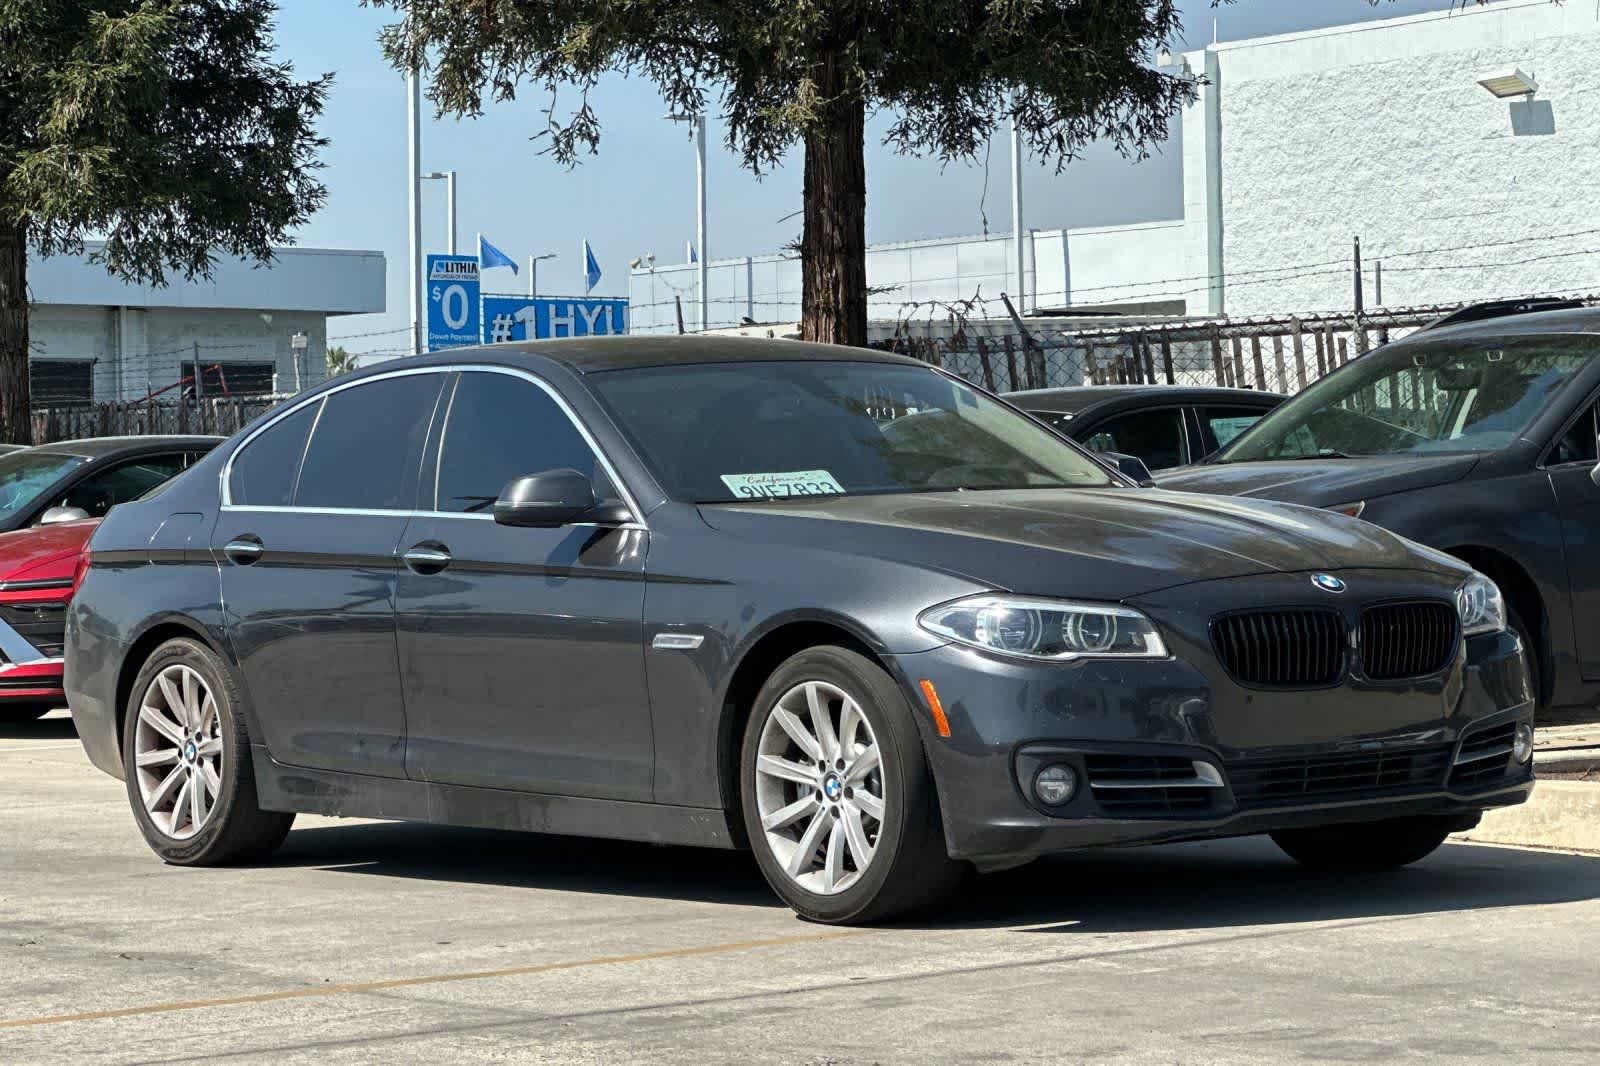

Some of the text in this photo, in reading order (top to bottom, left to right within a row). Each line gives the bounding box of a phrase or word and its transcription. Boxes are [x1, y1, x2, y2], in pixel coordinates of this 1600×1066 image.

[445, 262, 478, 273] LITHIA
[490, 305, 537, 343] #1
[747, 475, 805, 485] California
